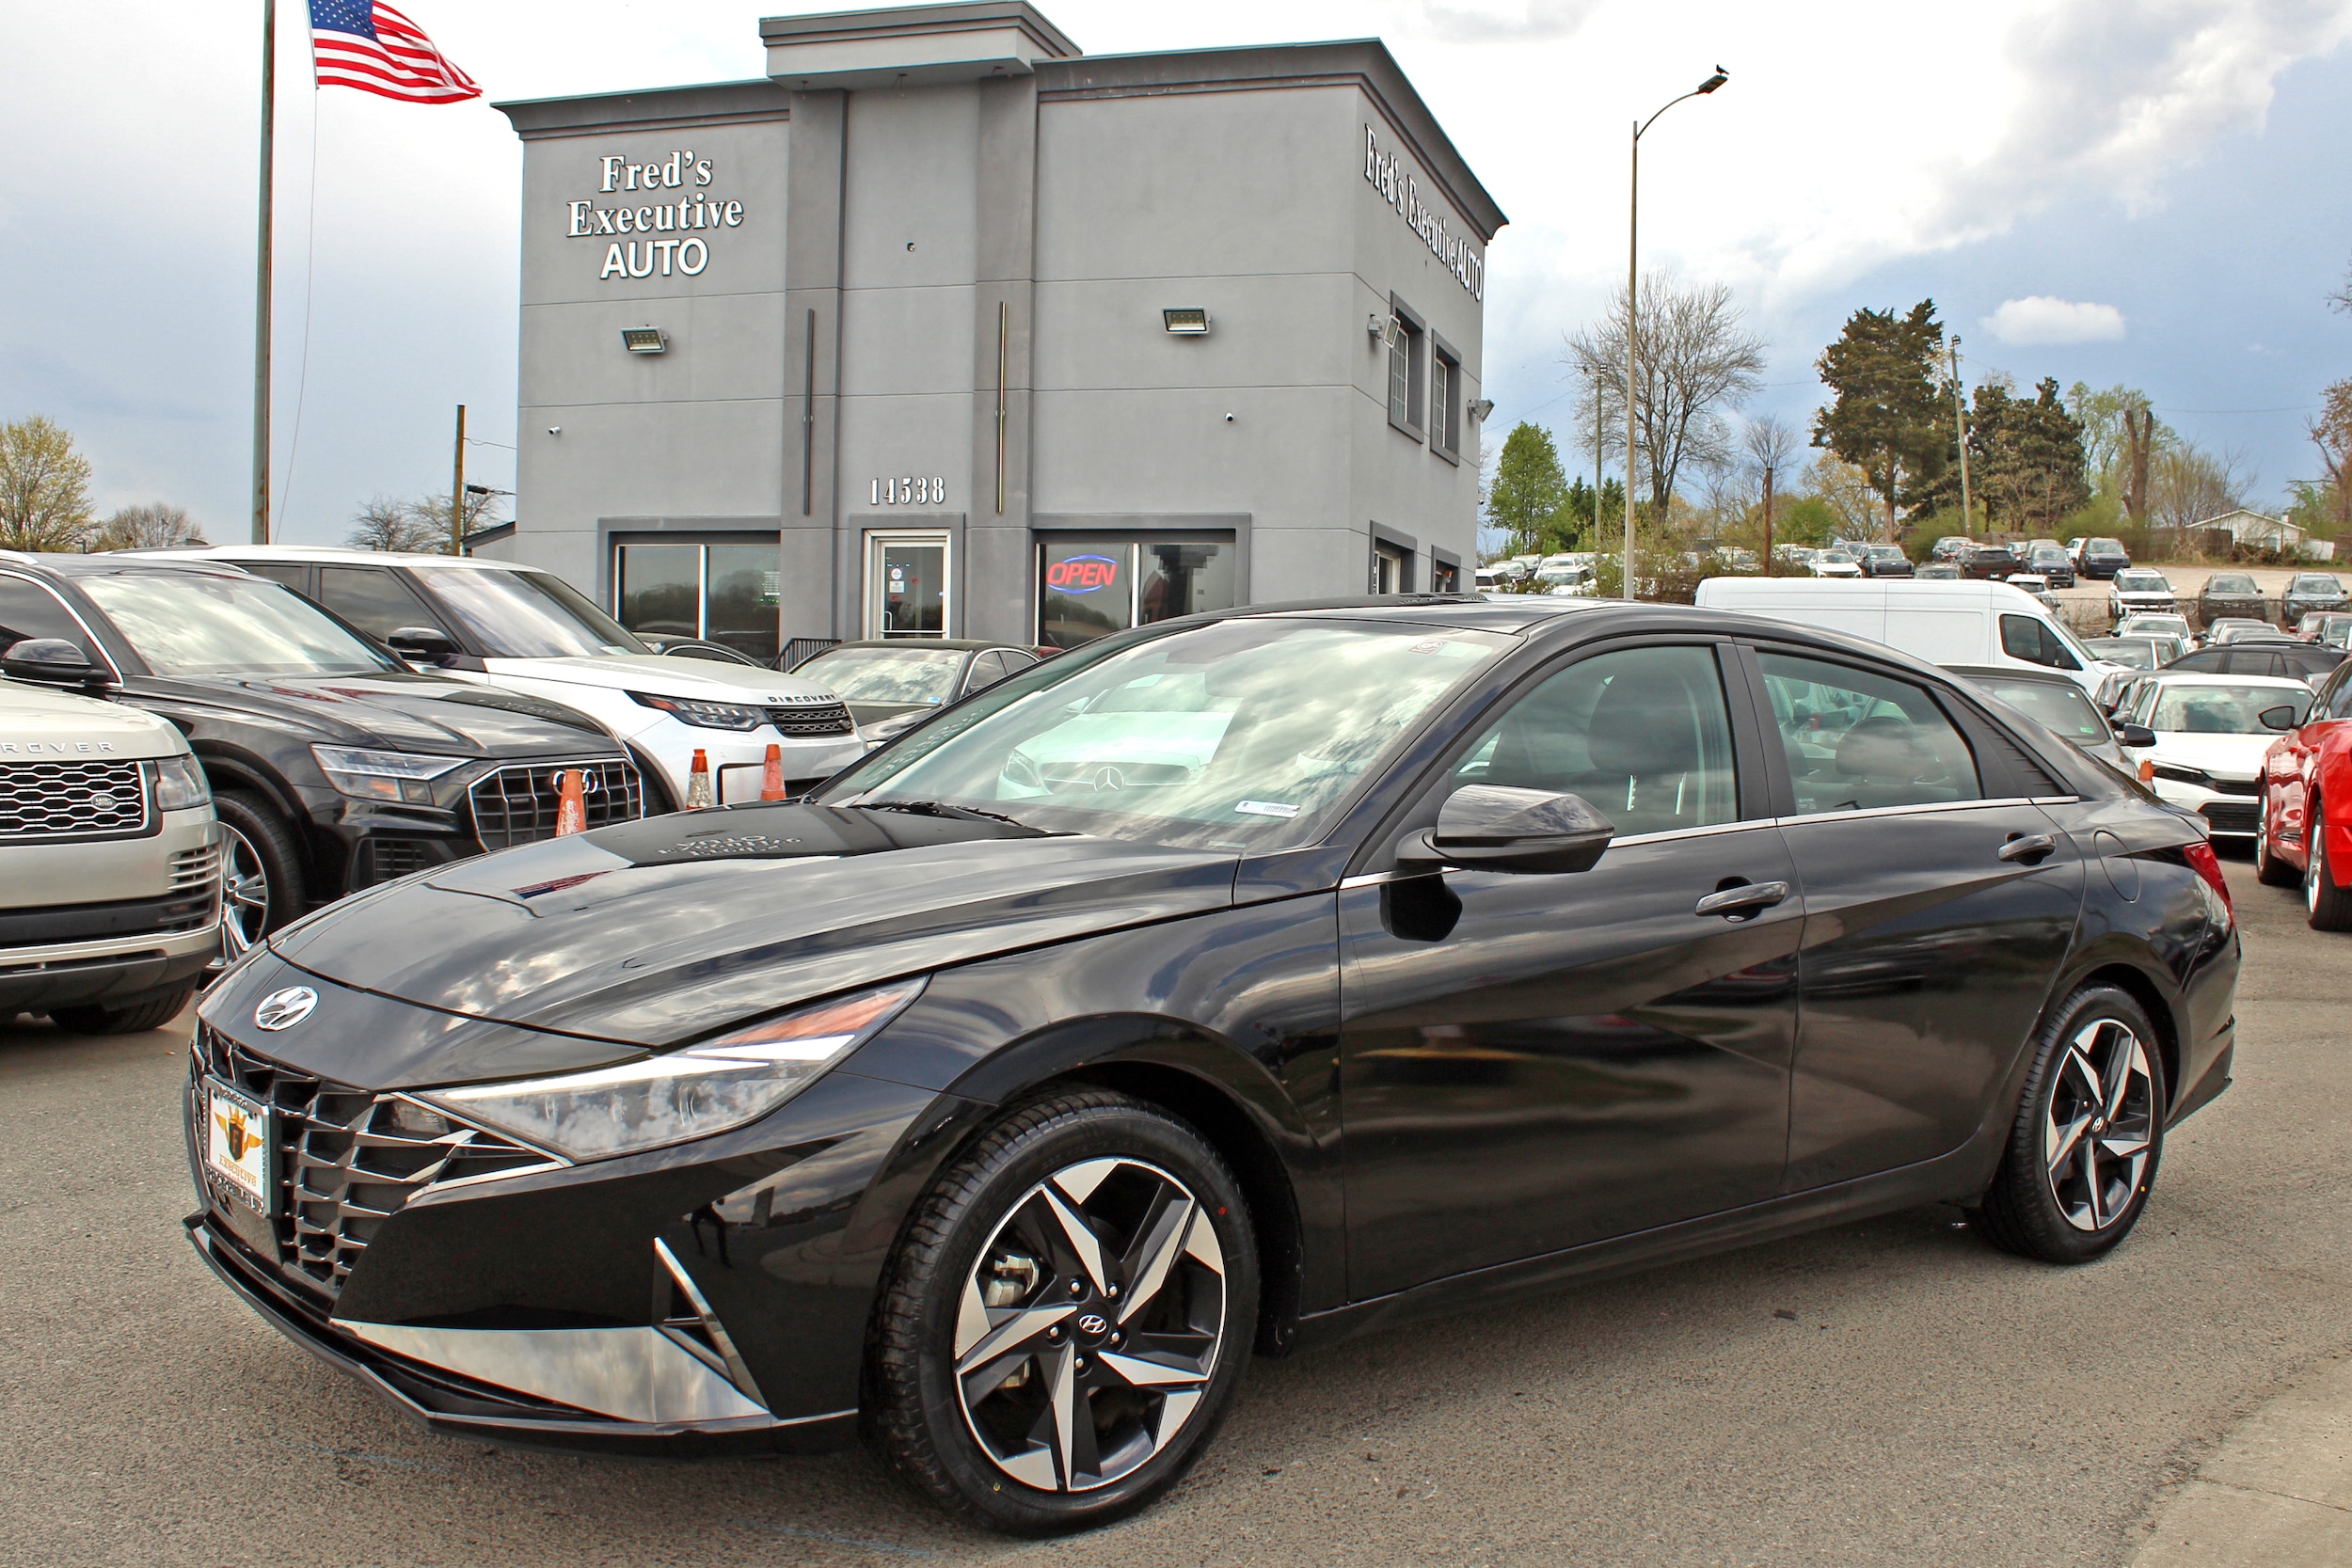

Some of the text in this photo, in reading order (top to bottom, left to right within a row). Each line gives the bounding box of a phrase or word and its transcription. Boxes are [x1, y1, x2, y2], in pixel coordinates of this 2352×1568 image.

[598, 150, 713, 193] Fred's
[566, 192, 744, 237] Executive
[1364, 123, 1483, 302] Fred's Executive AUTO
[599, 237, 709, 279] AUTO
[869, 476, 946, 505] 14538
[1047, 562, 1118, 585] OPEN
[767, 694, 836, 704] DISCOVERY
[0, 741, 115, 753] ROVER
